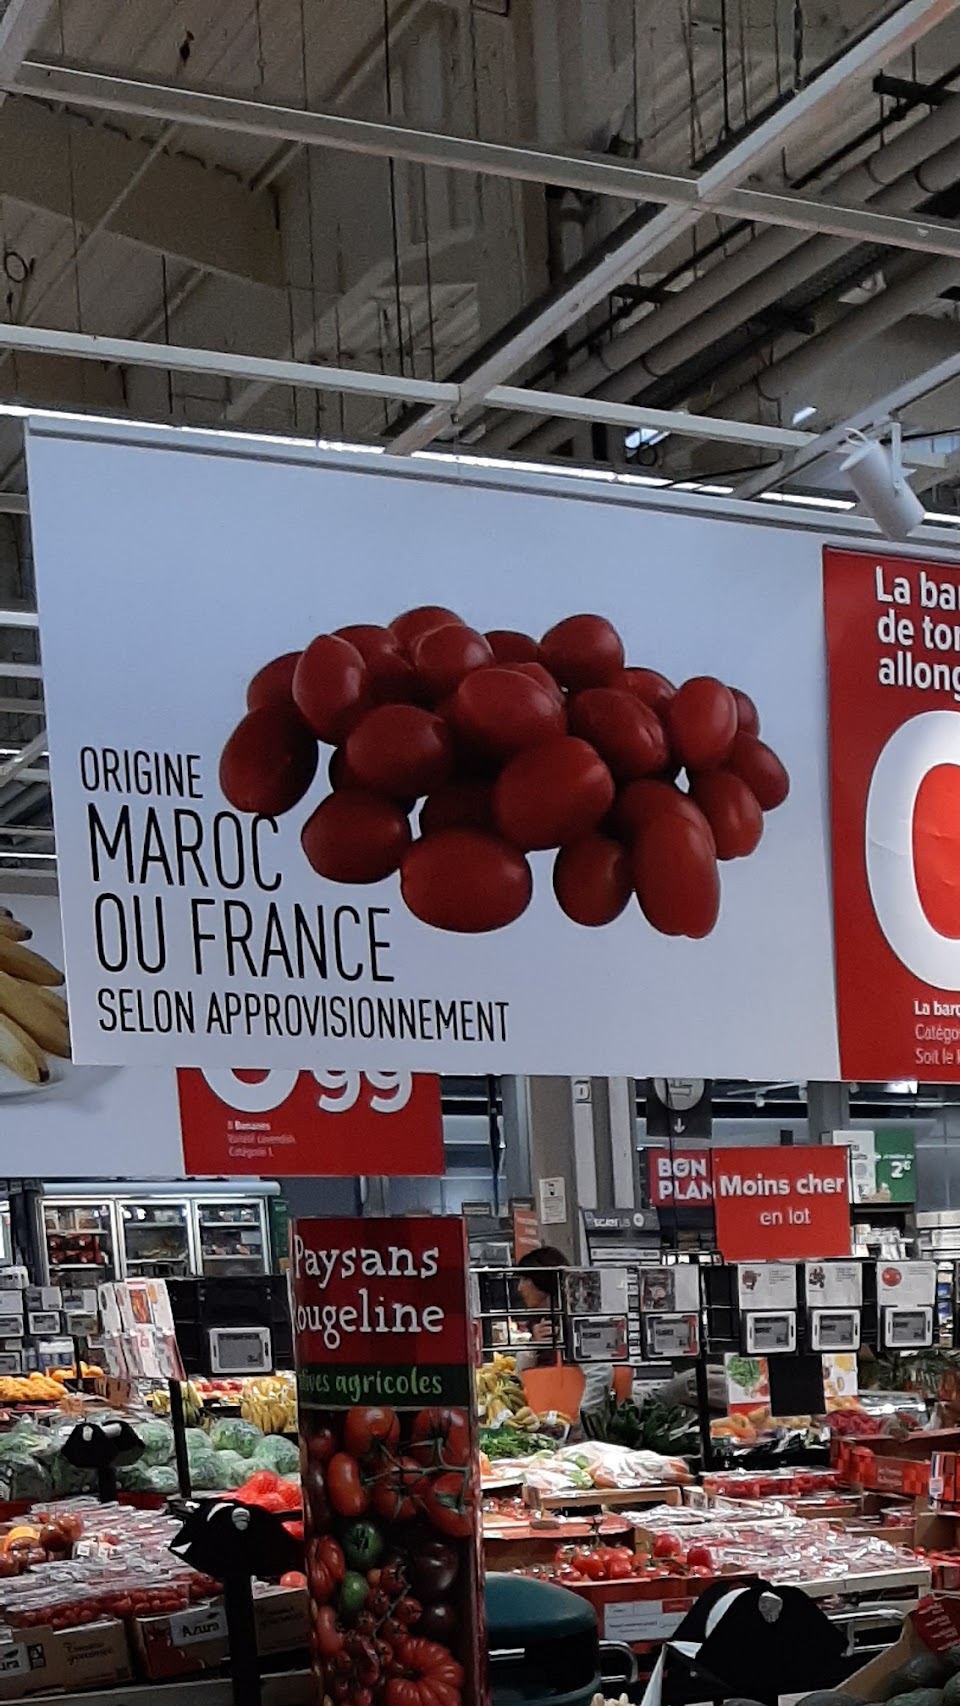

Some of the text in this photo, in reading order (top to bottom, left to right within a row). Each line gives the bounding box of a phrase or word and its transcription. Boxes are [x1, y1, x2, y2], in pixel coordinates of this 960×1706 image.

[875, 566, 911, 605] La
[877, 609, 914, 646] de
[80, 746, 204, 798] ORIGINE
[86, 803, 282, 892] MAROC
[93, 892, 395, 982] OU FRANCE
[97, 988, 510, 1042] SELON APPROVISIONNEMENT
[914, 1000, 930, 1015] La
[658, 1158, 706, 1177] BON
[720, 1173, 844, 1196] Moins cher
[659, 1180, 716, 1200] PLAN
[760, 1207, 811, 1225] en lot
[296, 1288, 445, 1349] ougeline
[335, 1366, 443, 1402] agricoles
[182, 1620, 220, 1638] Azura
